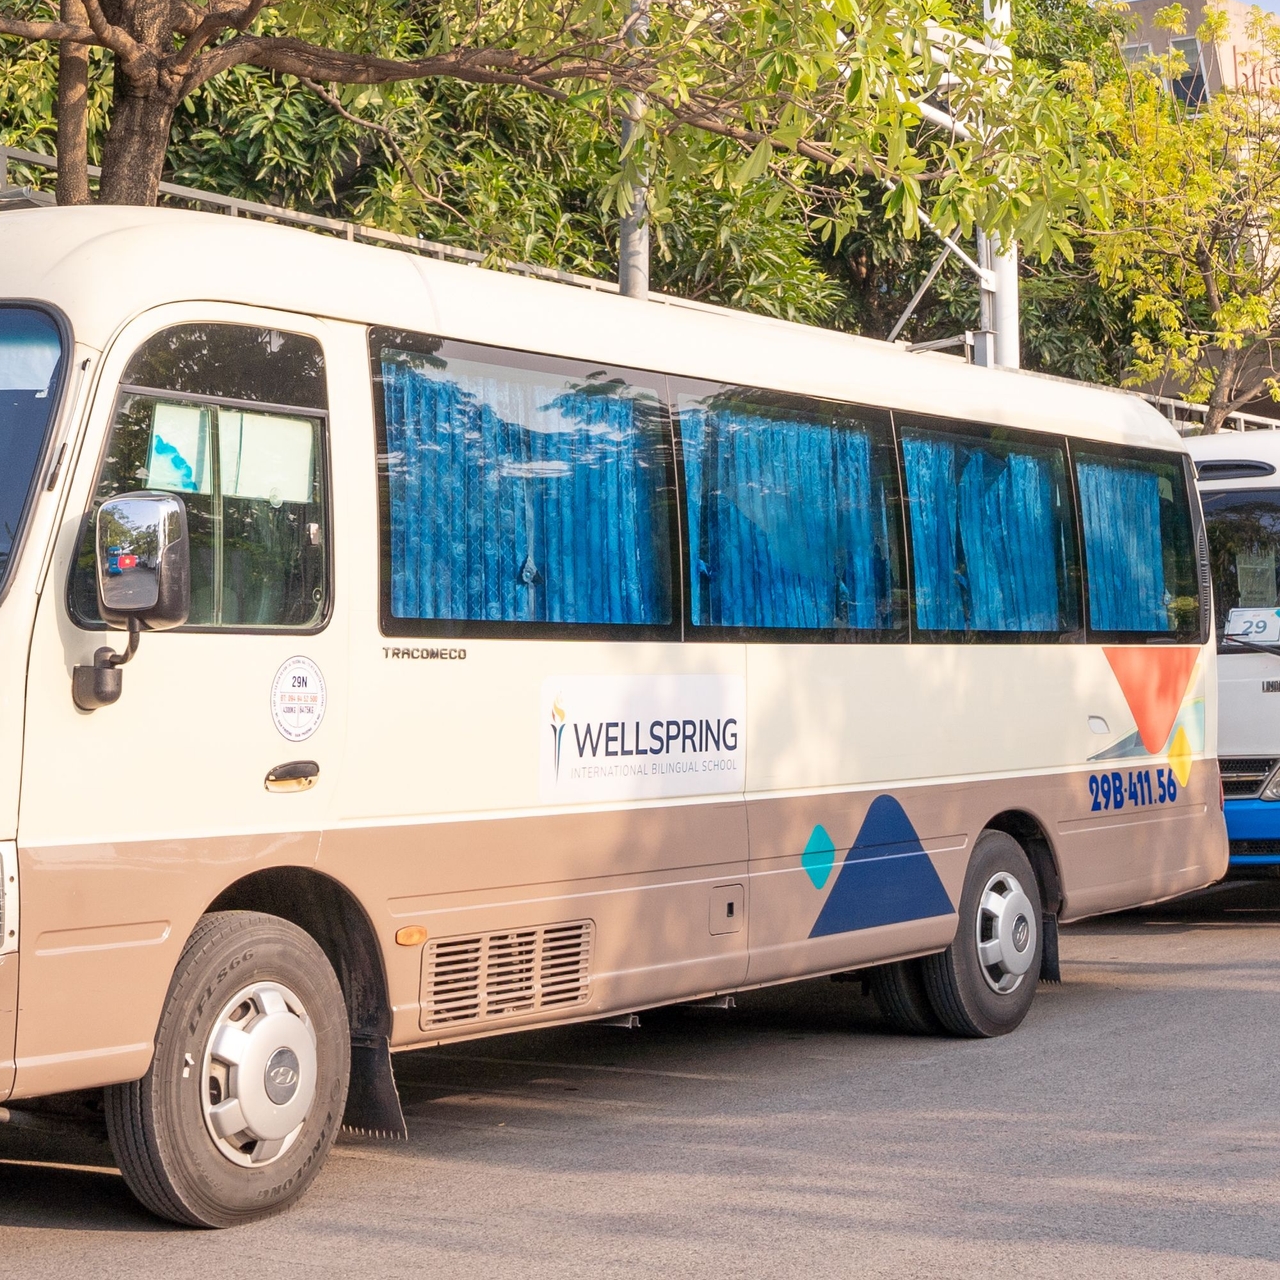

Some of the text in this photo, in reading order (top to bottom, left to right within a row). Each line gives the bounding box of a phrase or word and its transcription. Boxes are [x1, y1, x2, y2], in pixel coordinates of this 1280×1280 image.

[1241, 619, 1267, 635] 29
[382, 647, 467, 660] TRACOMECO
[291, 675, 308, 688] 29N
[573, 718, 738, 758] WELLSPRING
[571, 758, 737, 779] INTERNATIONAL BILINGUAL SCHOOL
